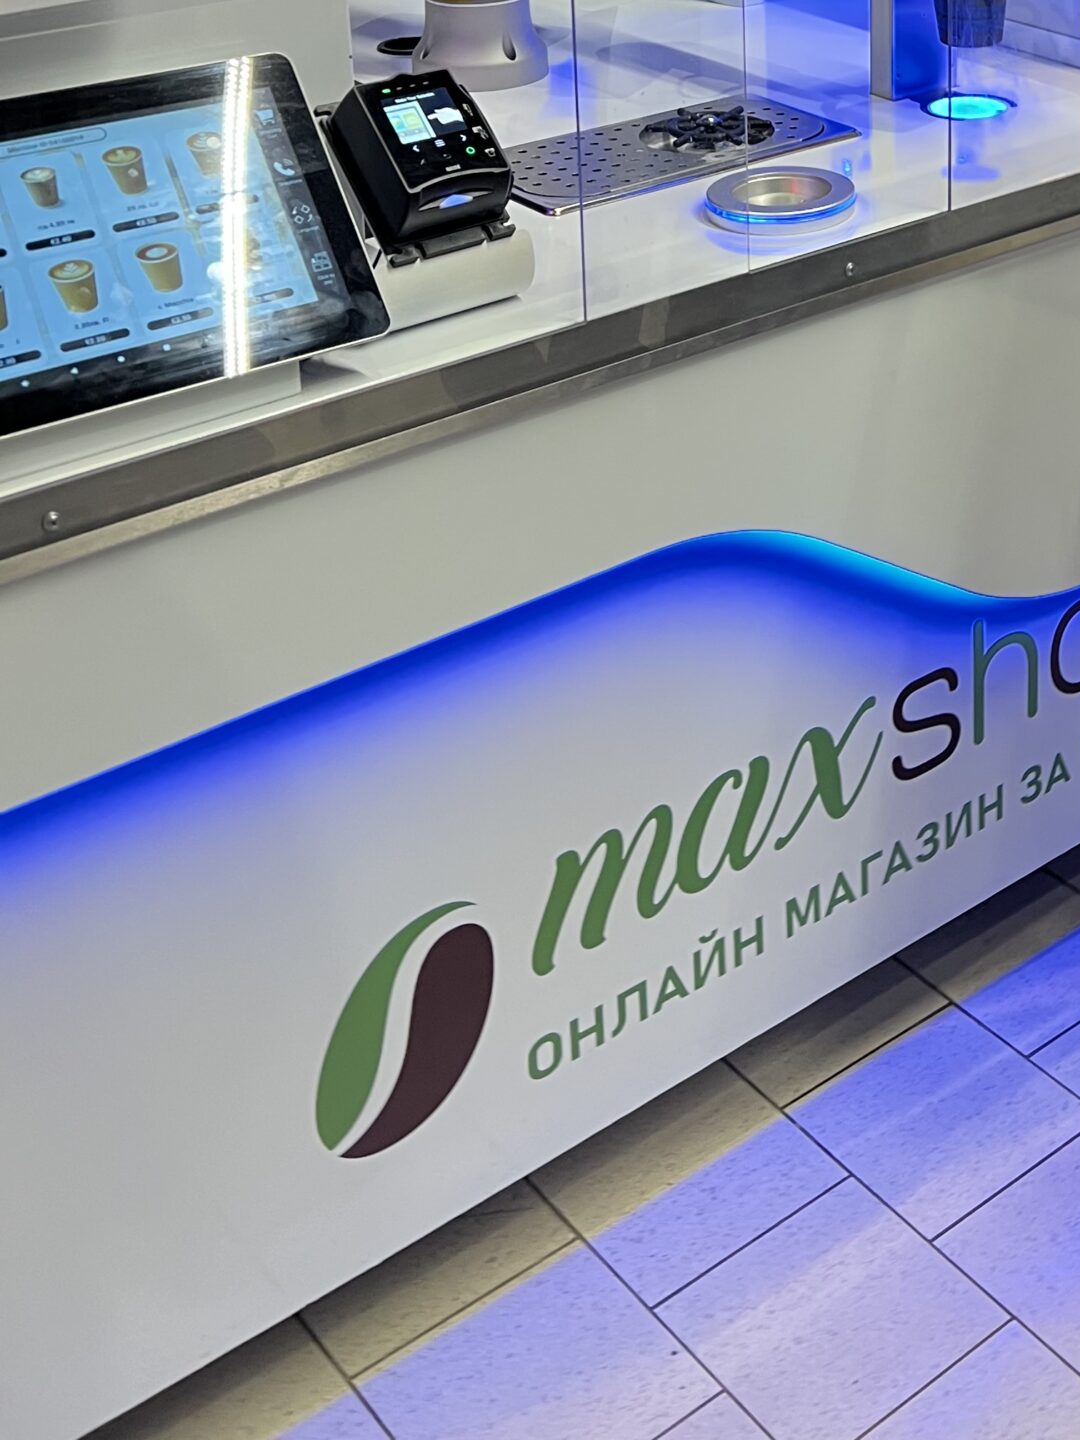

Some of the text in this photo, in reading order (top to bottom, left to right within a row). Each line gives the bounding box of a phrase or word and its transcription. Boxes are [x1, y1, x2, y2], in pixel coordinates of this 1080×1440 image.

[527, 915, 766, 1080] ОНЛАЙН
[785, 783, 1006, 939] МАГАЗИН
[1019, 752, 1071, 806] ЗА
